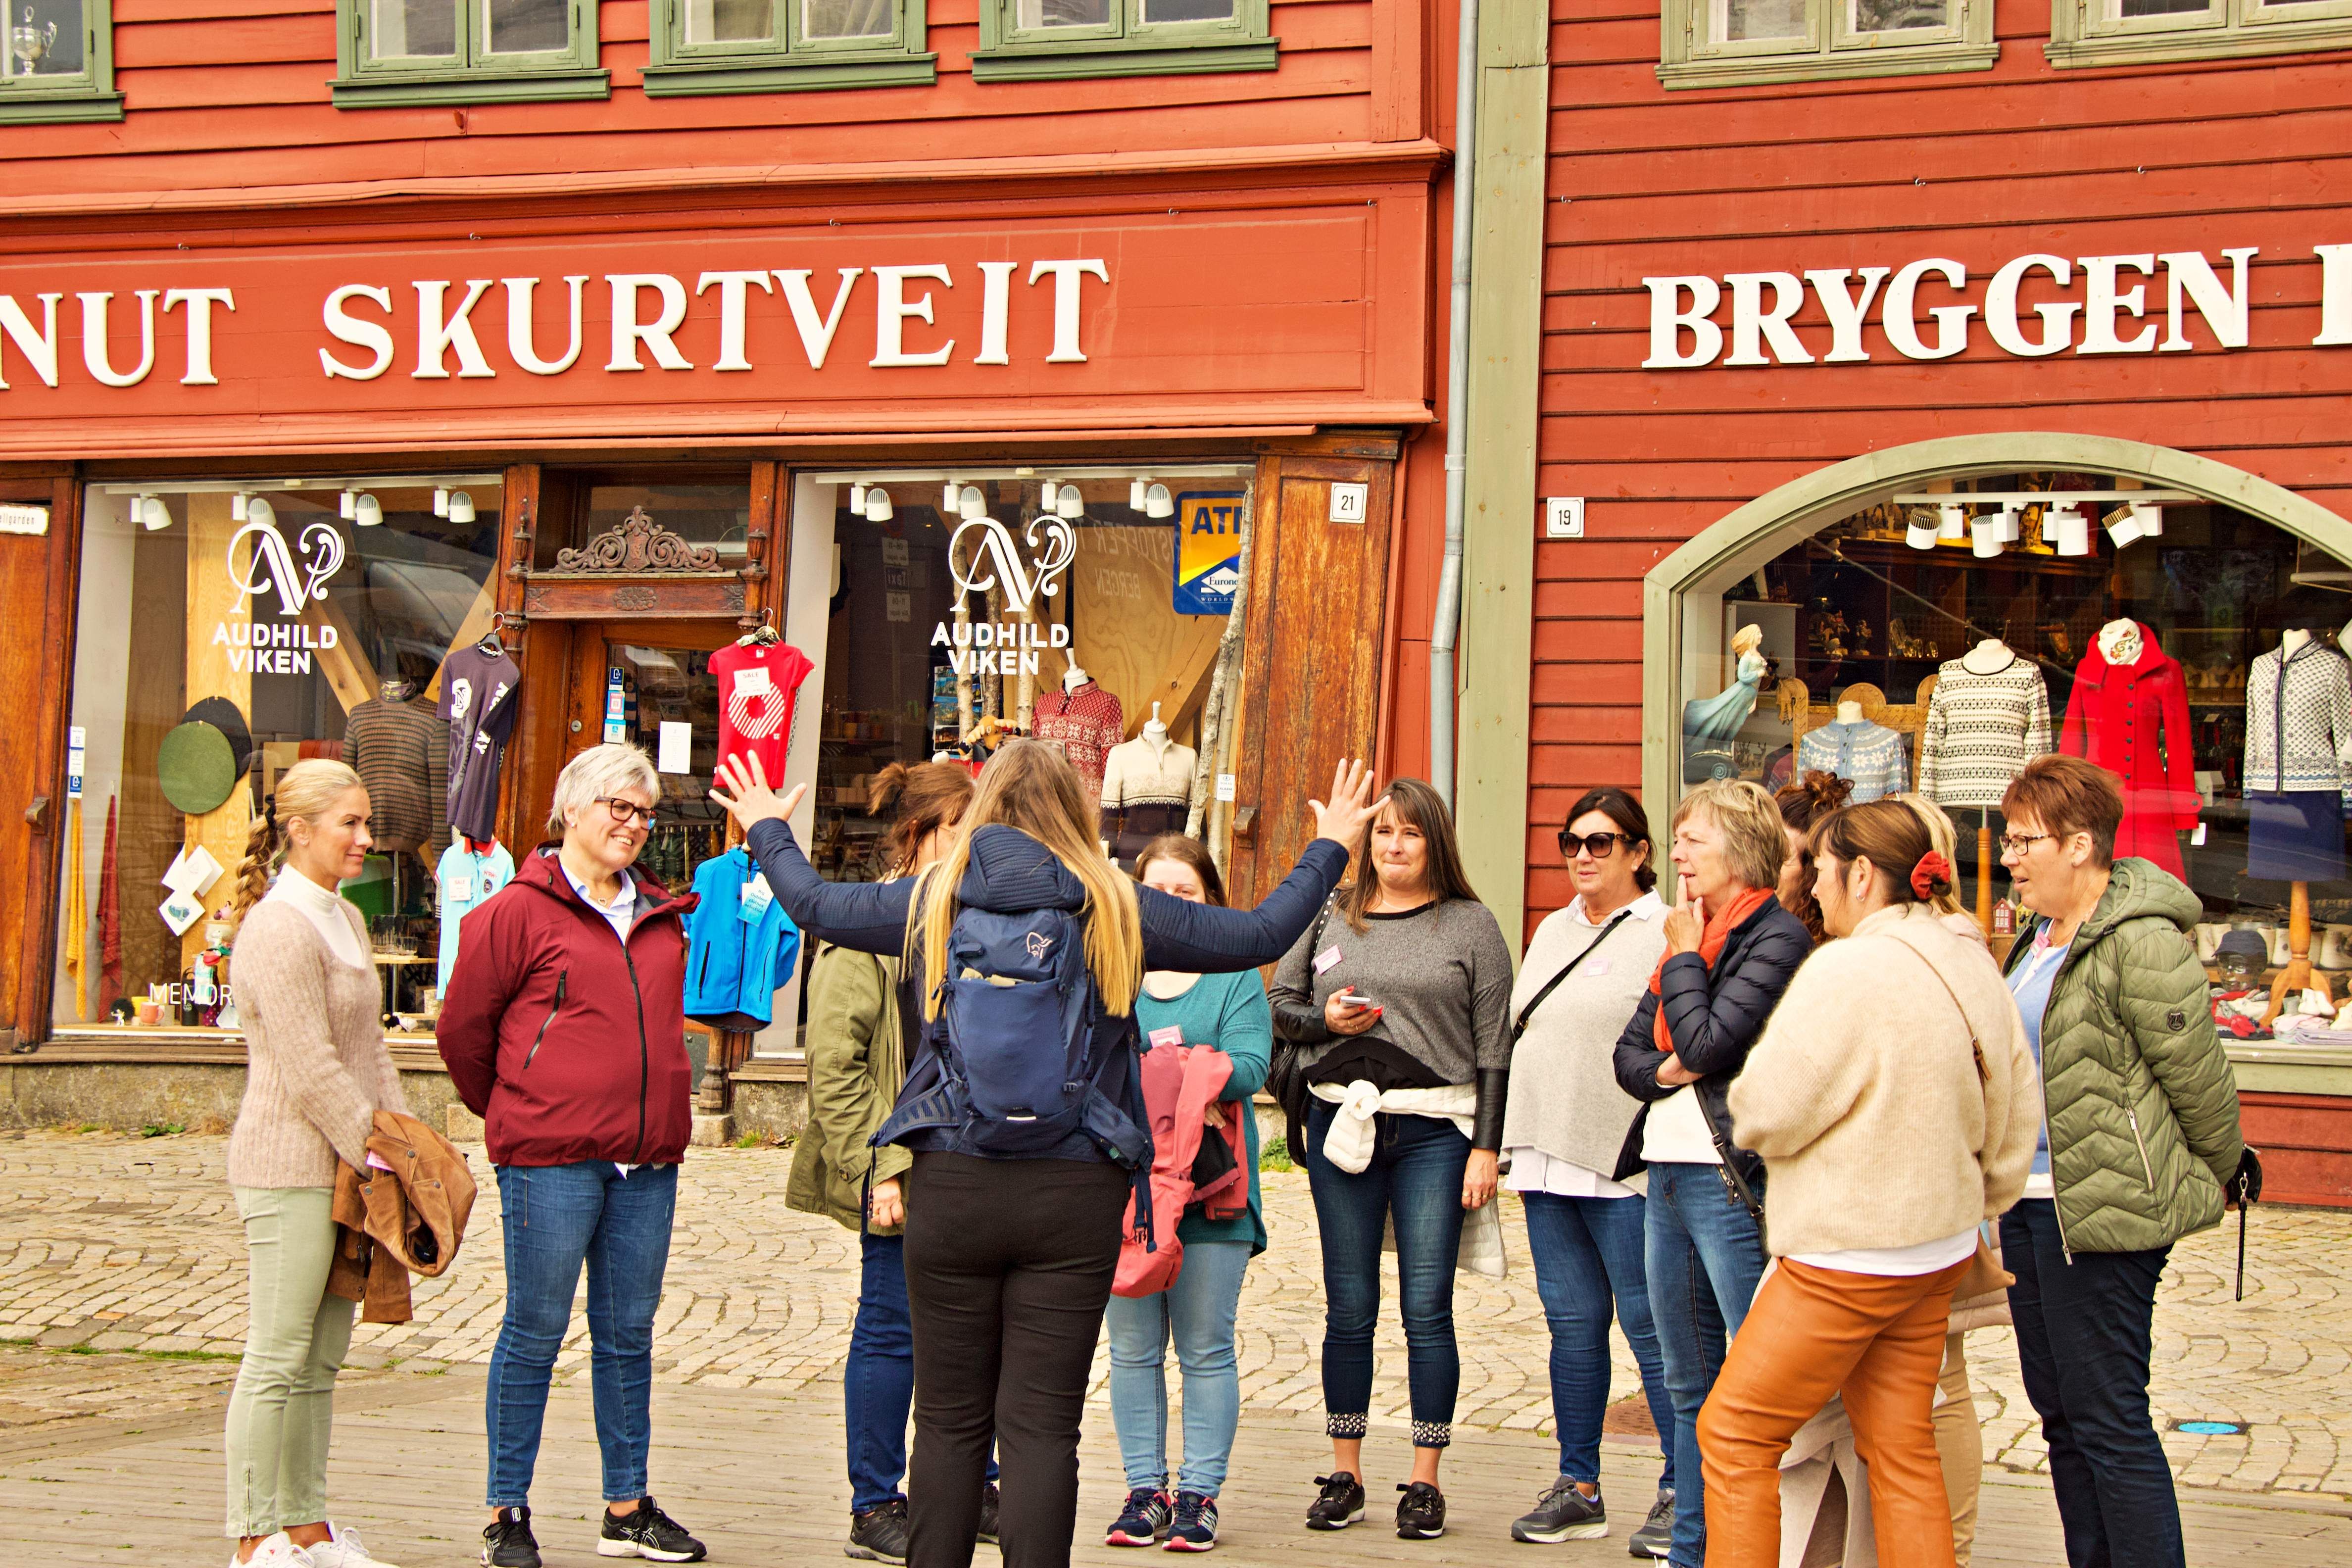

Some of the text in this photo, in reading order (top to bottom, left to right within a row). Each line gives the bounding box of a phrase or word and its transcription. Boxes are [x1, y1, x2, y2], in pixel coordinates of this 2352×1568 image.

[1641, 247, 2259, 368] BRYGGEN
[0, 259, 1109, 388] NUT SKURTVEIT
[1341, 495, 1354, 511] 21
[1559, 509, 1571, 525] 19
[212, 622, 339, 649] AUDHILD
[931, 622, 1070, 648] AUDHILD
[227, 649, 311, 675] VIKEN
[947, 650, 1039, 676] VIKEN
